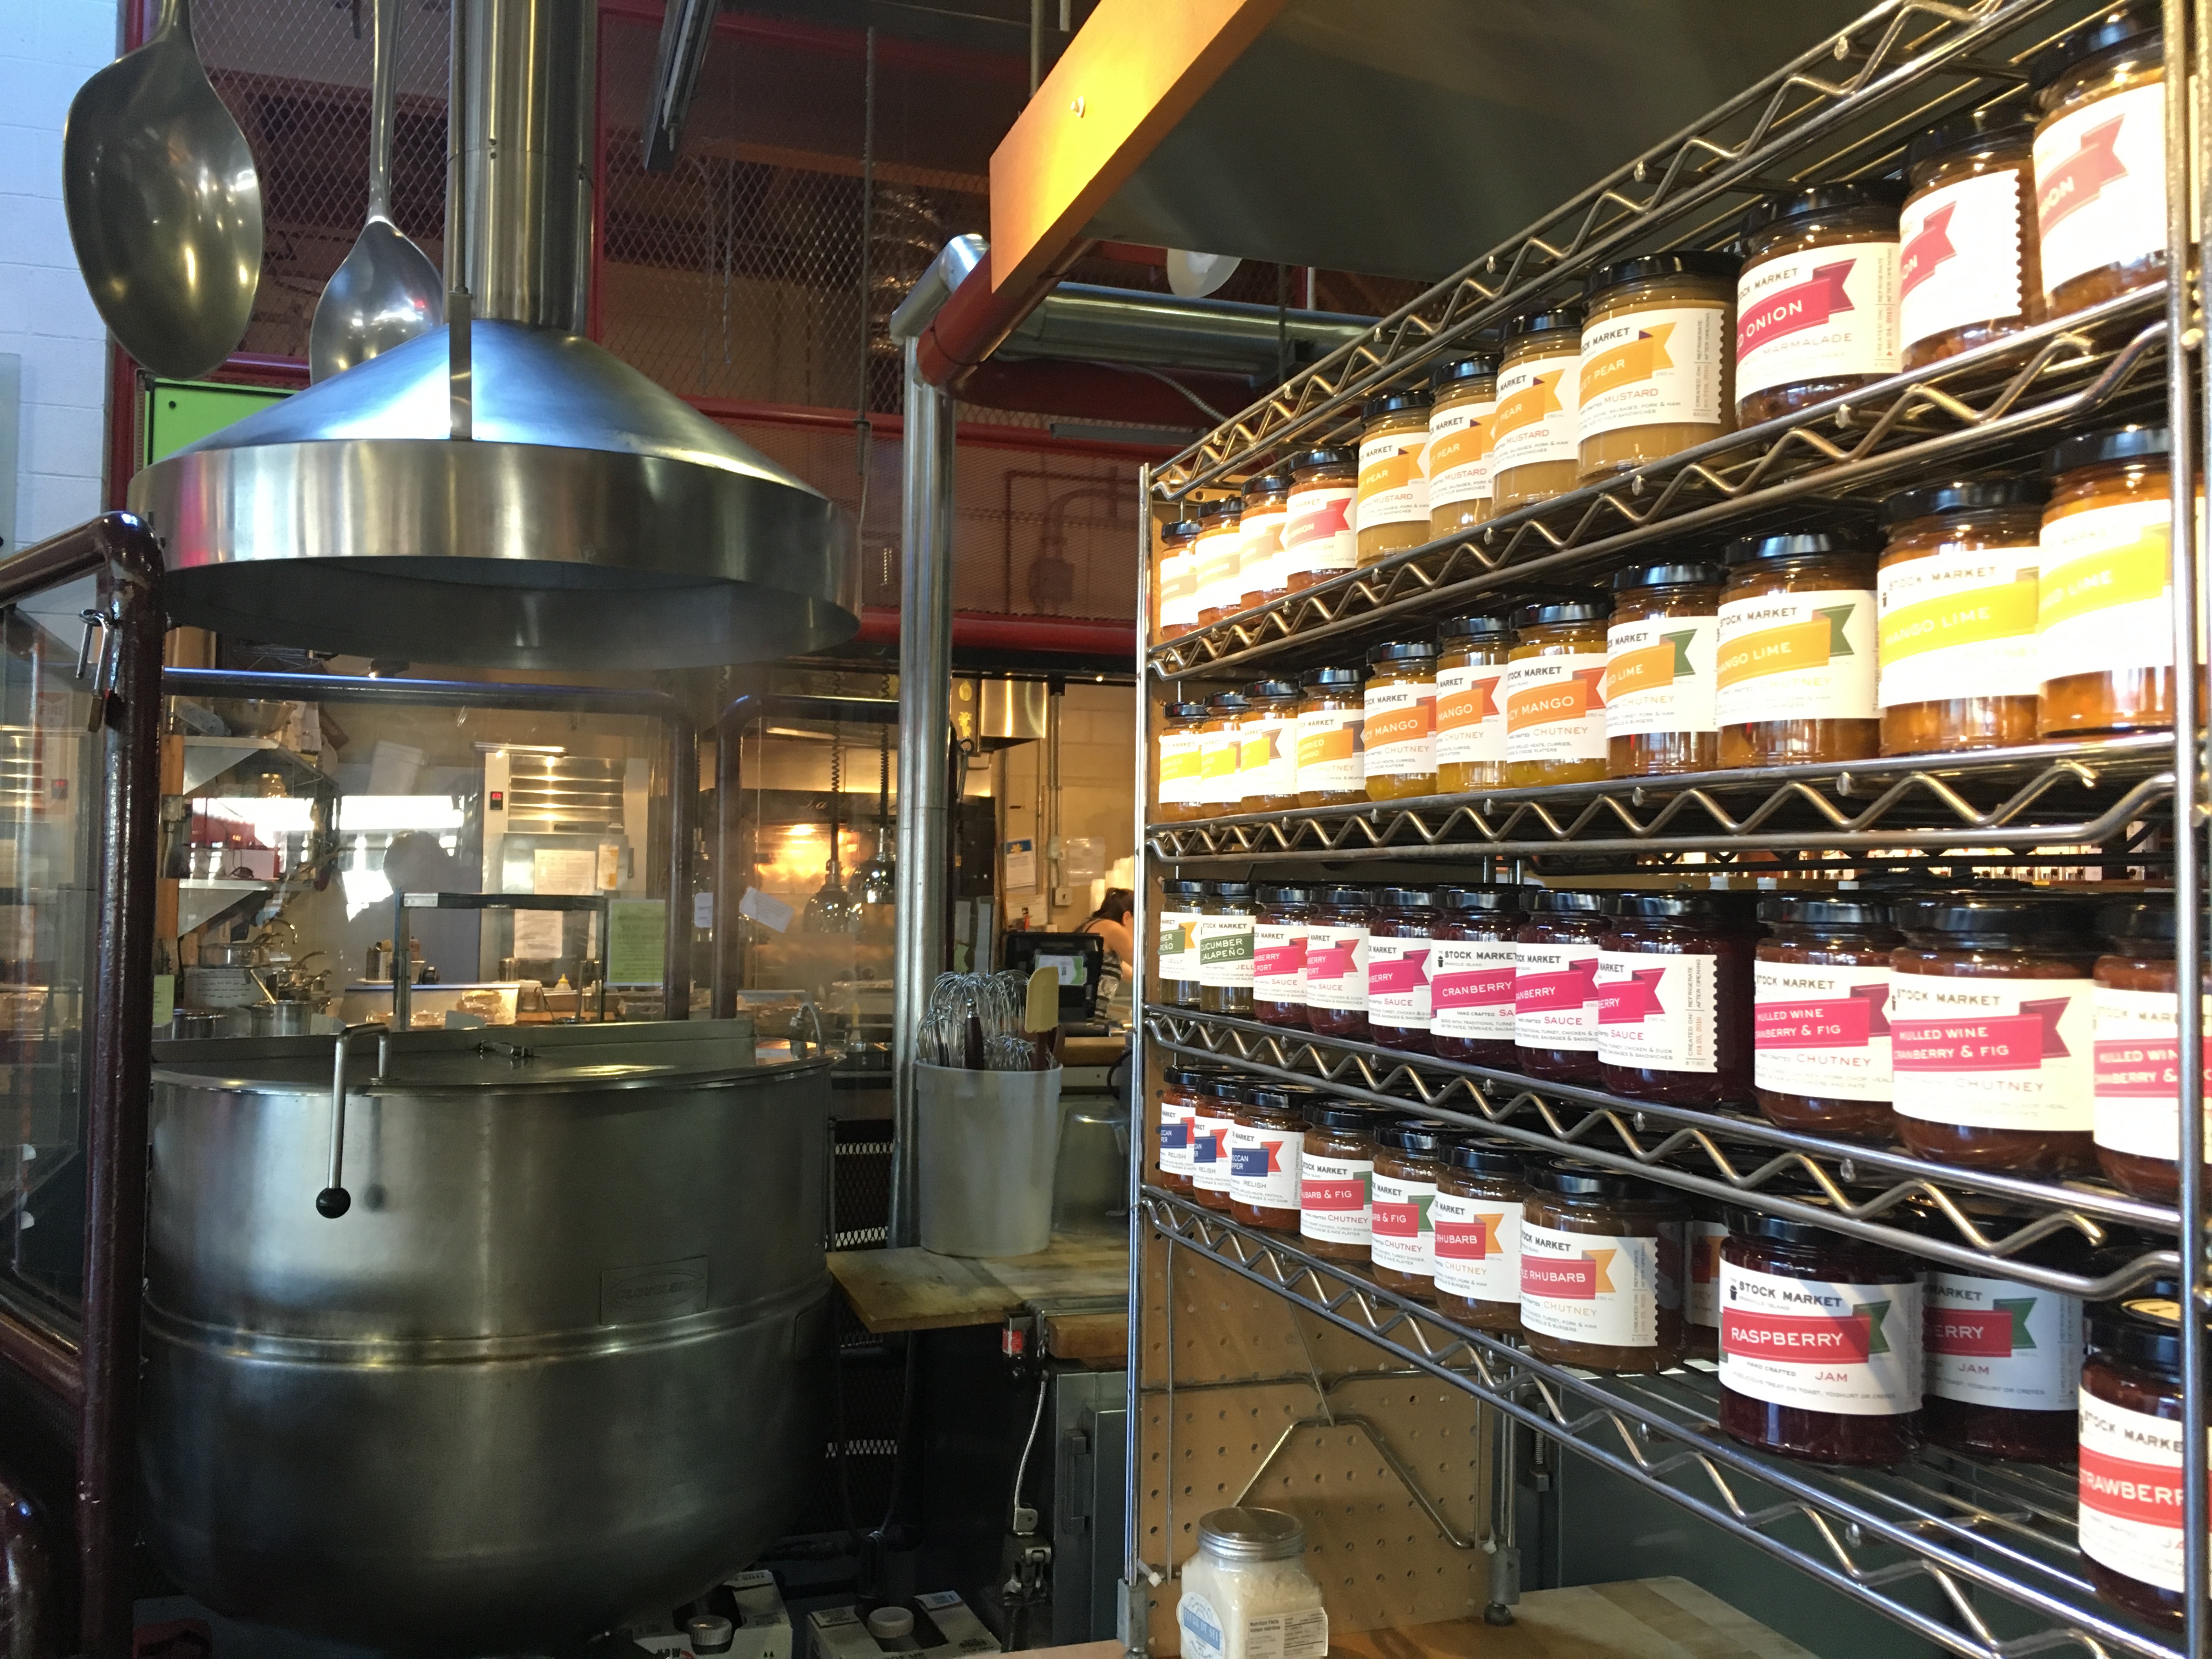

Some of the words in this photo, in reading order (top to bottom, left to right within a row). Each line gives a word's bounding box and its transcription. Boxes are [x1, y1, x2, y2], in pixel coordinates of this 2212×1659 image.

[1754, 267, 1799, 290] MARKET
[1746, 300, 1803, 337] ONION
[1593, 327, 1630, 346] MARKET
[1763, 333, 1853, 354] MARMALADE
[1594, 359, 1625, 380] PEAR
[1499, 375, 1527, 392] MARKET
[1604, 388, 1659, 404] MUSTARD
[1500, 404, 1522, 421] PEAR
[1436, 417, 1464, 431] MARKET
[1506, 430, 1550, 444] MUSTARD
[1367, 445, 1393, 458] MARKET
[1437, 443, 1460, 459] PEAR
[1367, 470, 1389, 485] PEAR
[1445, 468, 1487, 480] MUSTARD
[1374, 493, 1413, 504] MUSTARD
[1932, 567, 1997, 581] MARKET
[2068, 570, 2114, 596] LIME
[1747, 607, 1798, 620] MARKET
[1942, 606, 1992, 628] LIME
[1615, 633, 1649, 646] MARKET
[1753, 642, 1792, 661] LIME
[1525, 667, 1562, 677] MARKET
[1618, 664, 1644, 681] LIME
[1440, 678, 1464, 688] MARKET
[1378, 695, 1408, 703] MARKET
[1522, 696, 1574, 715] MANGO
[1622, 695, 1675, 708] CHUTNEY
[1437, 704, 1472, 721] MANGO
[1375, 719, 1418, 734] MANGO
[1534, 726, 1588, 736] CHUTNEY
[1444, 732, 1484, 741] CHUTNEY
[1385, 746, 1430, 754] CHUTNEY
[1201, 939, 1243, 952] CUCUMBER
[1373, 946, 1397, 954] MARKET
[1201, 947, 1245, 961] JALAPEÑO
[1444, 951, 1472, 959] STOCK
[1527, 955, 1561, 964] MARKET
[1599, 962, 1624, 973] MARKET
[1318, 983, 1343, 991] SAUCE
[1756, 974, 1778, 986] STOCK
[1783, 978, 1835, 990] MARKET
[1442, 981, 1512, 997] CRANBERRY
[1384, 998, 1413, 1007] SAUCE
[1937, 994, 2001, 1006] MARKET
[1790, 1008, 1824, 1019] WINE
[1544, 1016, 1583, 1025] SAUCE
[1611, 1029, 1644, 1041] SAUCE
[1801, 1024, 1812, 1036] &
[1817, 1025, 1841, 1035] FIG
[1945, 1027, 1989, 1039] WINE
[1960, 1045, 1973, 1058] &
[1980, 1045, 2009, 1057] FIG
[1797, 1053, 1871, 1067] CHUTNEY
[1955, 1077, 2045, 1092] CHUTNEY
[1235, 1133, 1255, 1142] MARKET
[1317, 1166, 1348, 1175] MARKET
[1243, 1180, 1267, 1189] RELISH
[1377, 1184, 1402, 1197] MARKET
[1324, 1189, 1332, 1199] &
[1335, 1190, 1352, 1198] FIG
[1439, 1203, 1466, 1216] MARKET
[1328, 1214, 1369, 1224] CHUTNEY
[1383, 1212, 1389, 1223] &
[1391, 1214, 1407, 1223] FIG
[1437, 1234, 1477, 1244] RHUBARB
[1535, 1237, 1571, 1252] MARKET
[1385, 1239, 1423, 1253] CHUTNEY
[1445, 1261, 1487, 1276] CHUTNEY
[1530, 1271, 1586, 1283] RHUBARB
[1737, 1281, 1776, 1299] STOCK
[1782, 1291, 1843, 1308] MARKET
[1543, 1301, 1598, 1317] CHUTNEY
[1731, 1328, 1843, 1346] RASPBERRY
[1764, 1365, 1797, 1377] CRAFTED
[1957, 1362, 1990, 1376] JAM
[1815, 1370, 1848, 1383] JAM
[2124, 1428, 2183, 1453] MARKE
